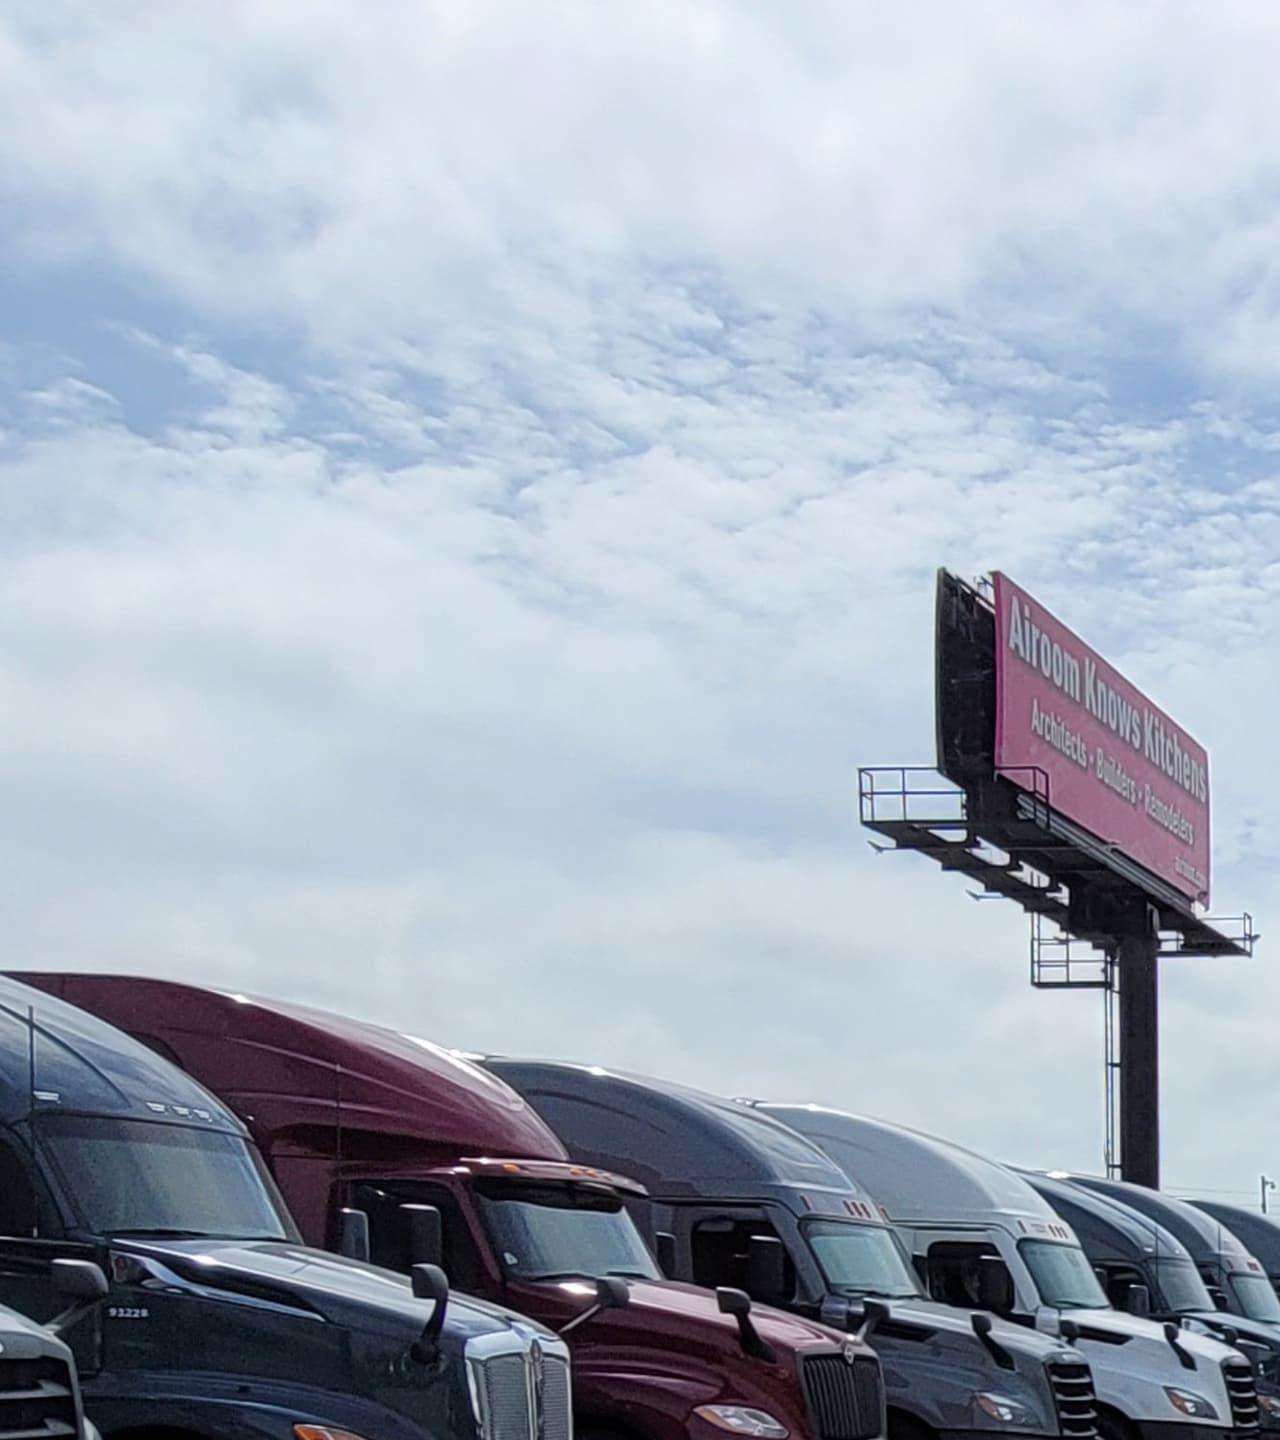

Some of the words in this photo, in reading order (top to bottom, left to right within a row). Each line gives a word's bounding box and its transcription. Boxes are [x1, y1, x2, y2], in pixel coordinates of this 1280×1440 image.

[1008, 594, 1080, 703] Airoom
[1084, 656, 1141, 750] Knows
[1143, 706, 1207, 803] Kitchens
[1032, 697, 1087, 768] Architects
